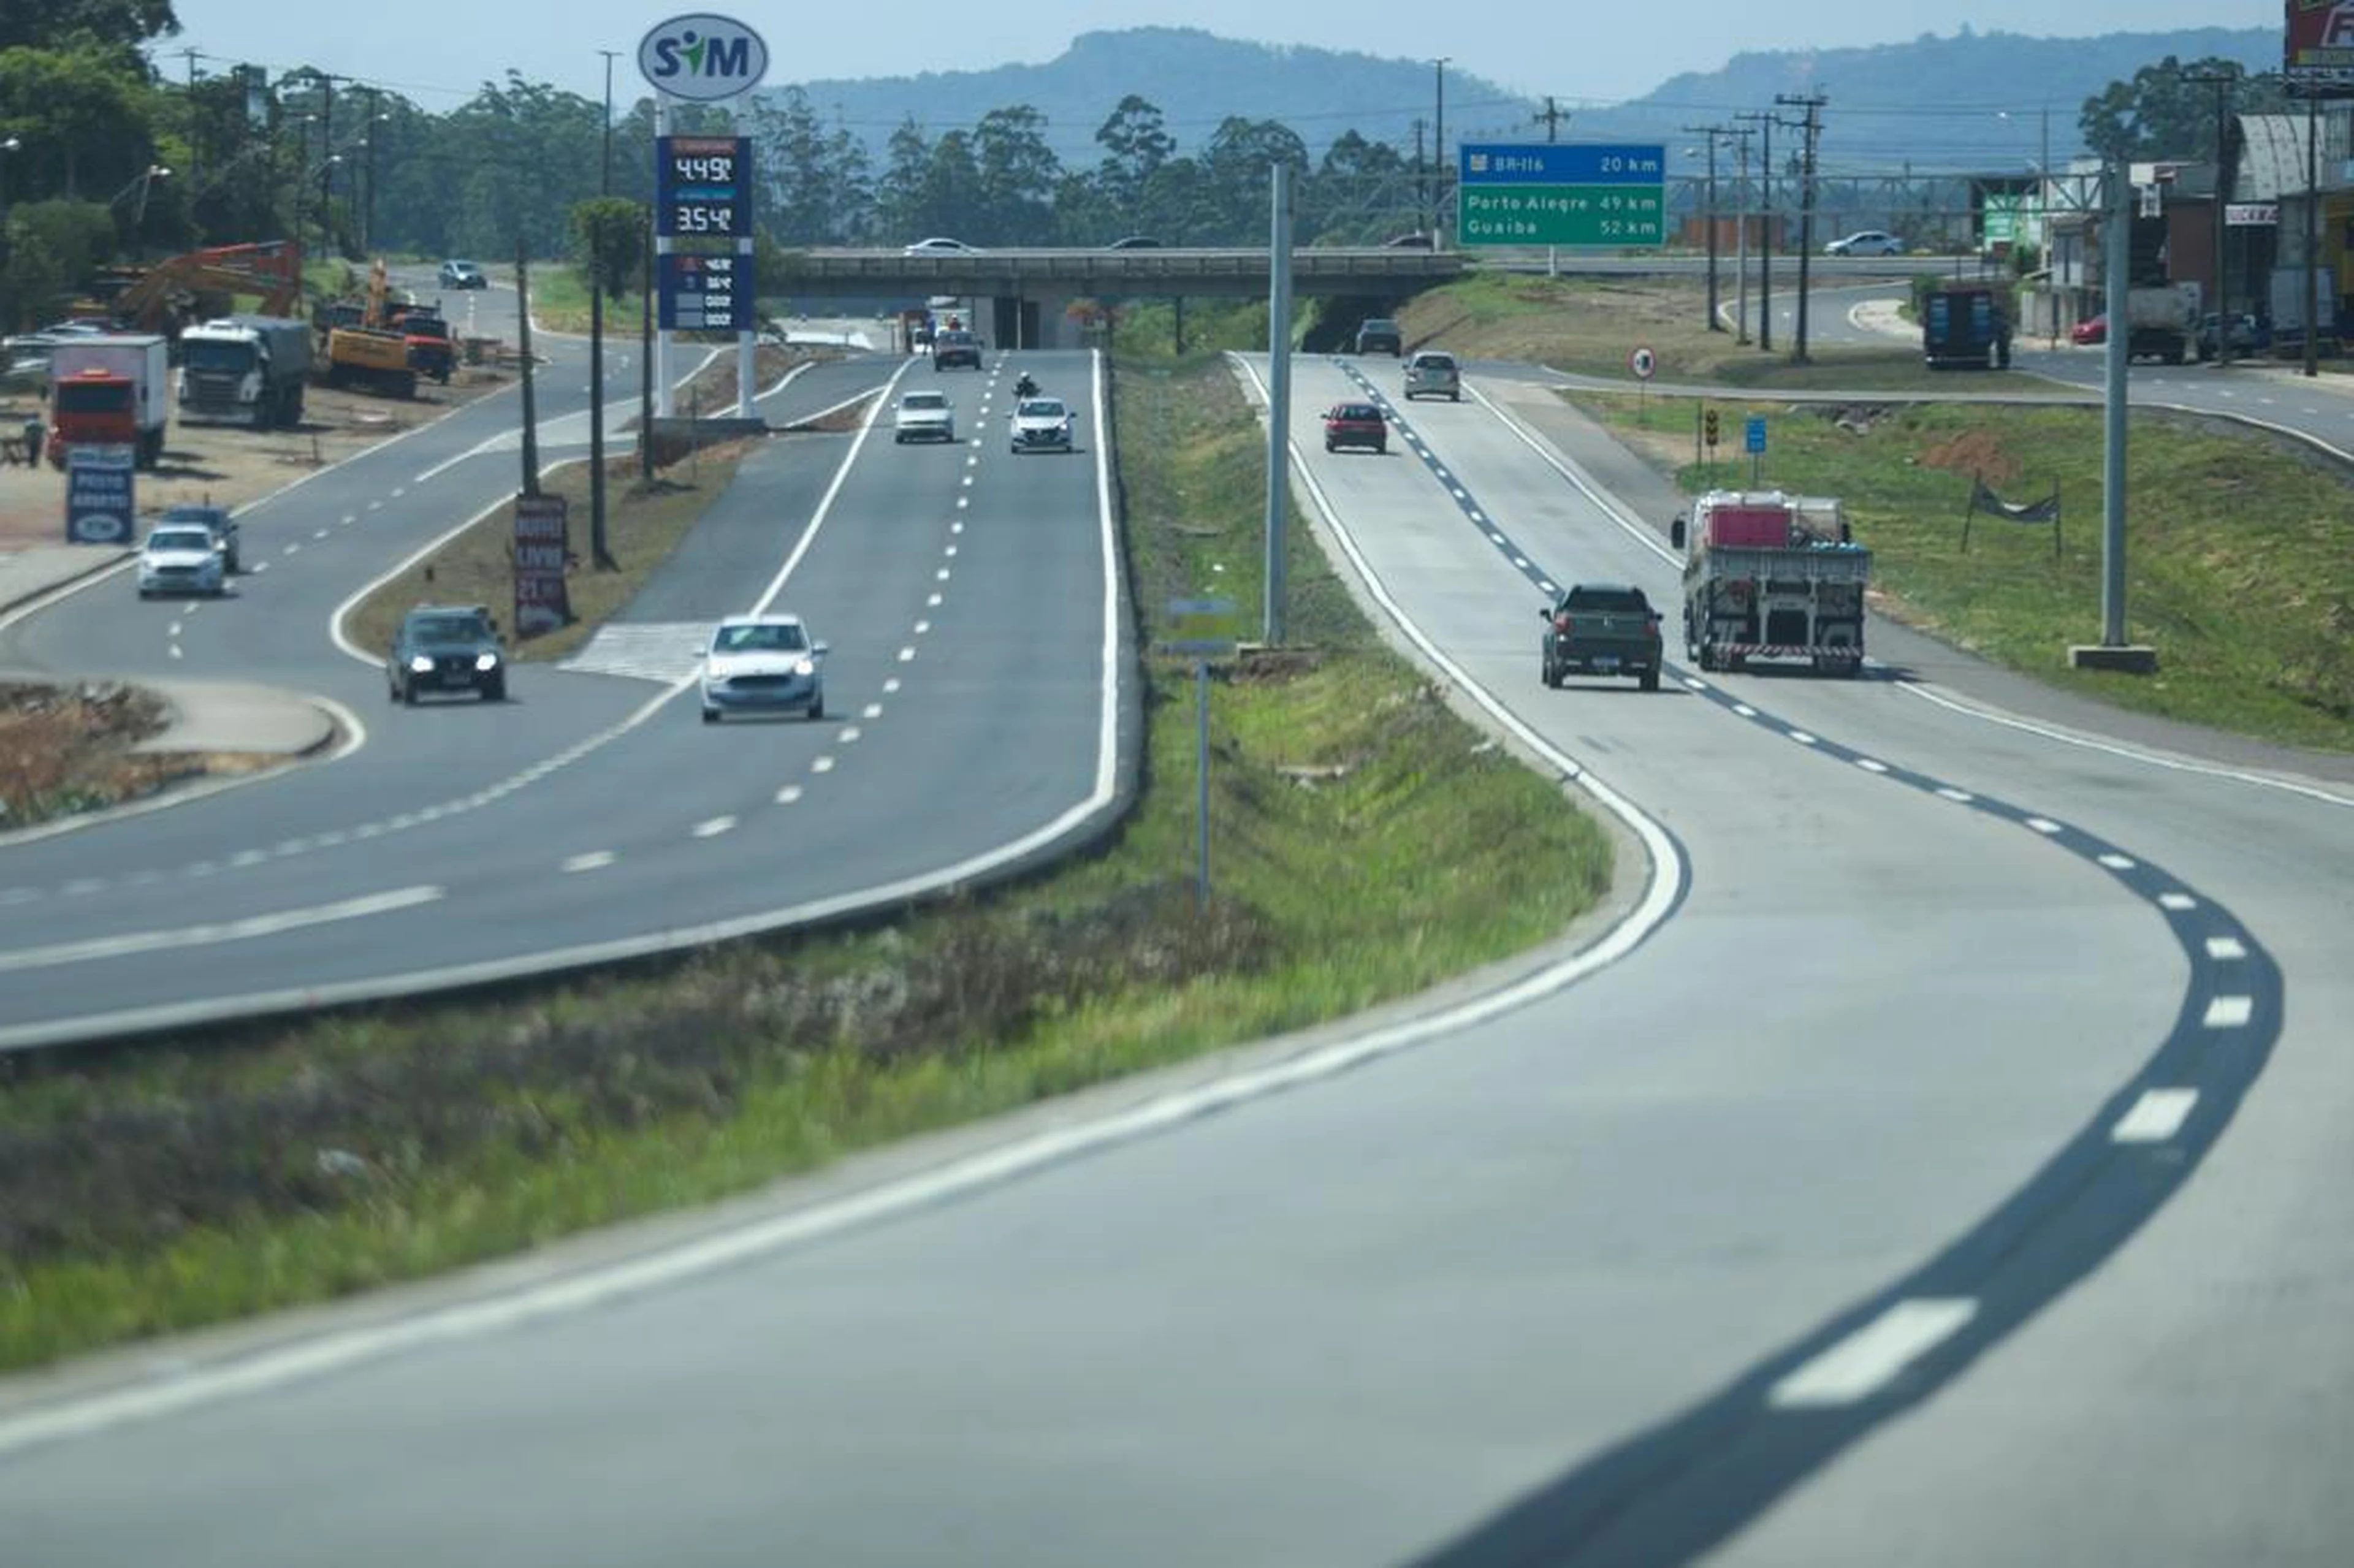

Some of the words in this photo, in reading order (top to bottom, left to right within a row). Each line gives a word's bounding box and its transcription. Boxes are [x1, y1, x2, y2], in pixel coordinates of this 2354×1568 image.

[1600, 156, 1622, 172] 20
[1629, 156, 1657, 172] km
[1468, 196, 1521, 210] Porto
[1526, 196, 1588, 214] Alegre
[1599, 196, 1621, 210] 49
[1628, 196, 1656, 210] km
[1600, 219, 1622, 235] 52
[1627, 219, 1656, 234] km
